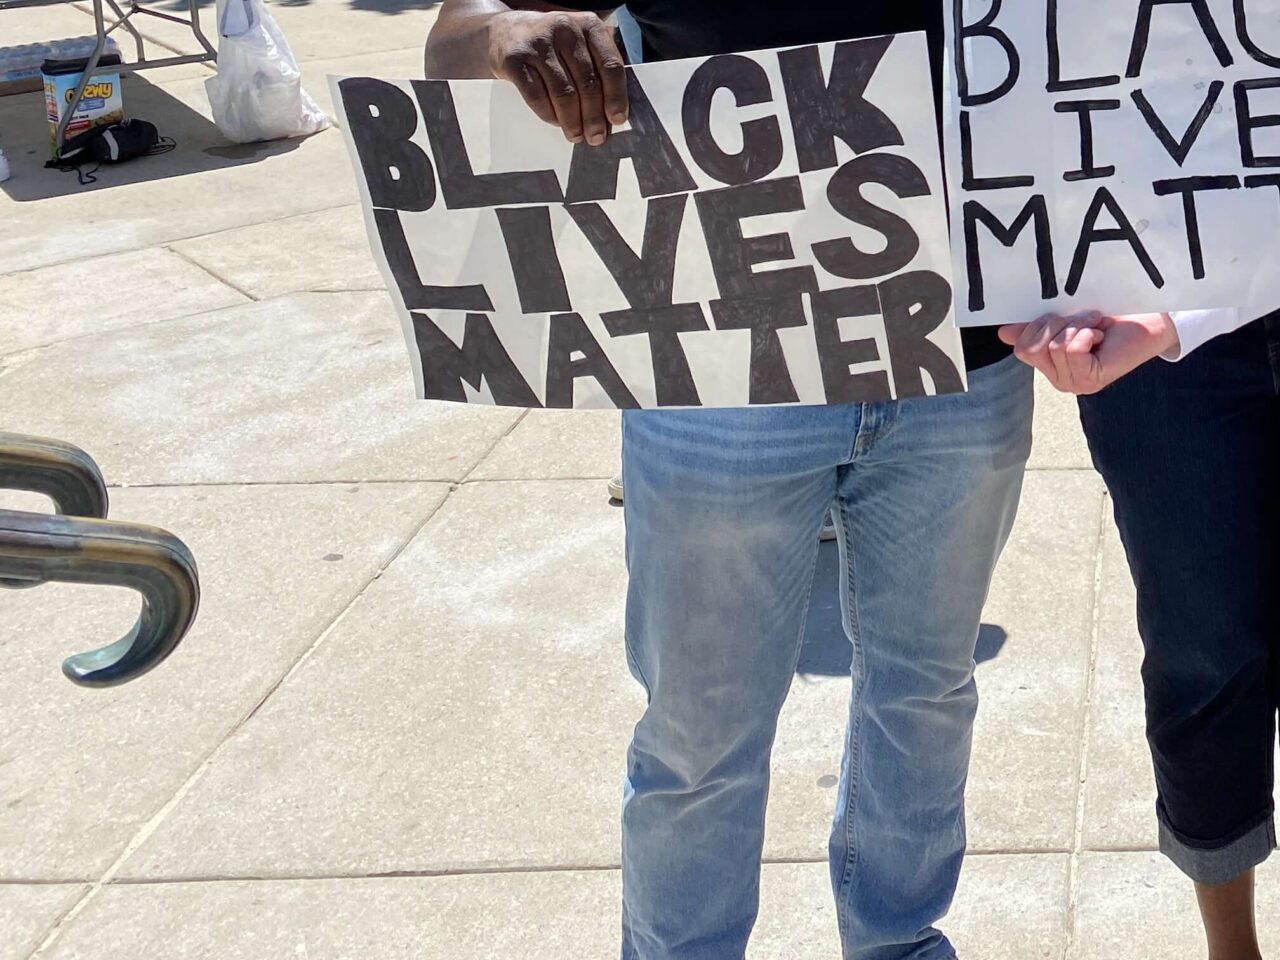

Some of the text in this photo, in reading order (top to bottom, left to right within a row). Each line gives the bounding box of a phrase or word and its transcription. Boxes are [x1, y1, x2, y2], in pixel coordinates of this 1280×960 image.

[338, 35, 905, 211] BLACK
[373, 153, 932, 313] LIVES
[411, 269, 965, 409] MATTER
